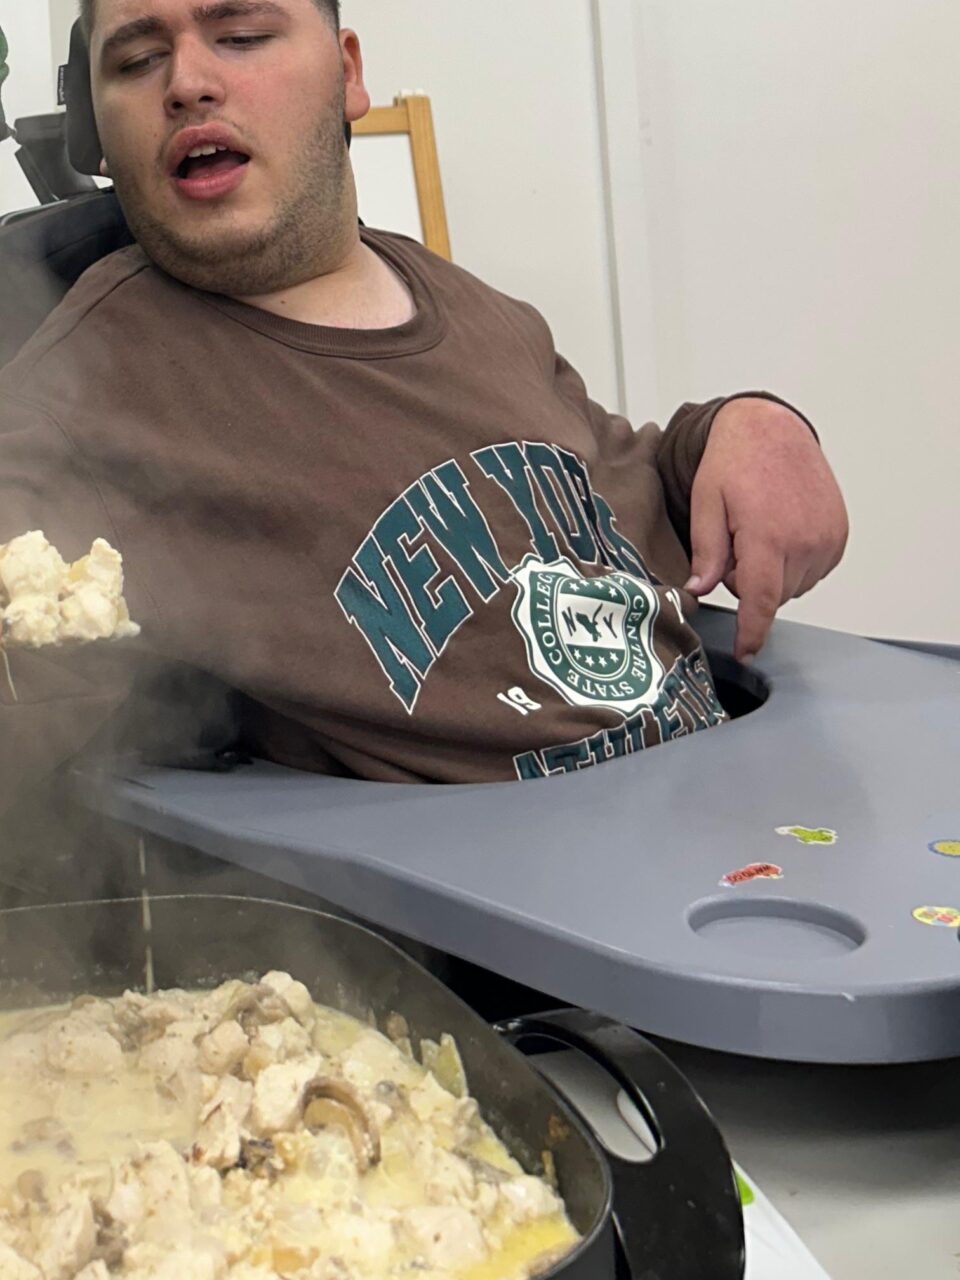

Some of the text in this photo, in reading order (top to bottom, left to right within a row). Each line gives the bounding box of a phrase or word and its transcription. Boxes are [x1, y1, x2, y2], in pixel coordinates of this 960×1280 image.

[334, 458, 511, 715] NEW
[561, 606, 618, 639] N Y
[627, 595, 647, 682] CENTRE
[567, 669, 635, 698] STATE
